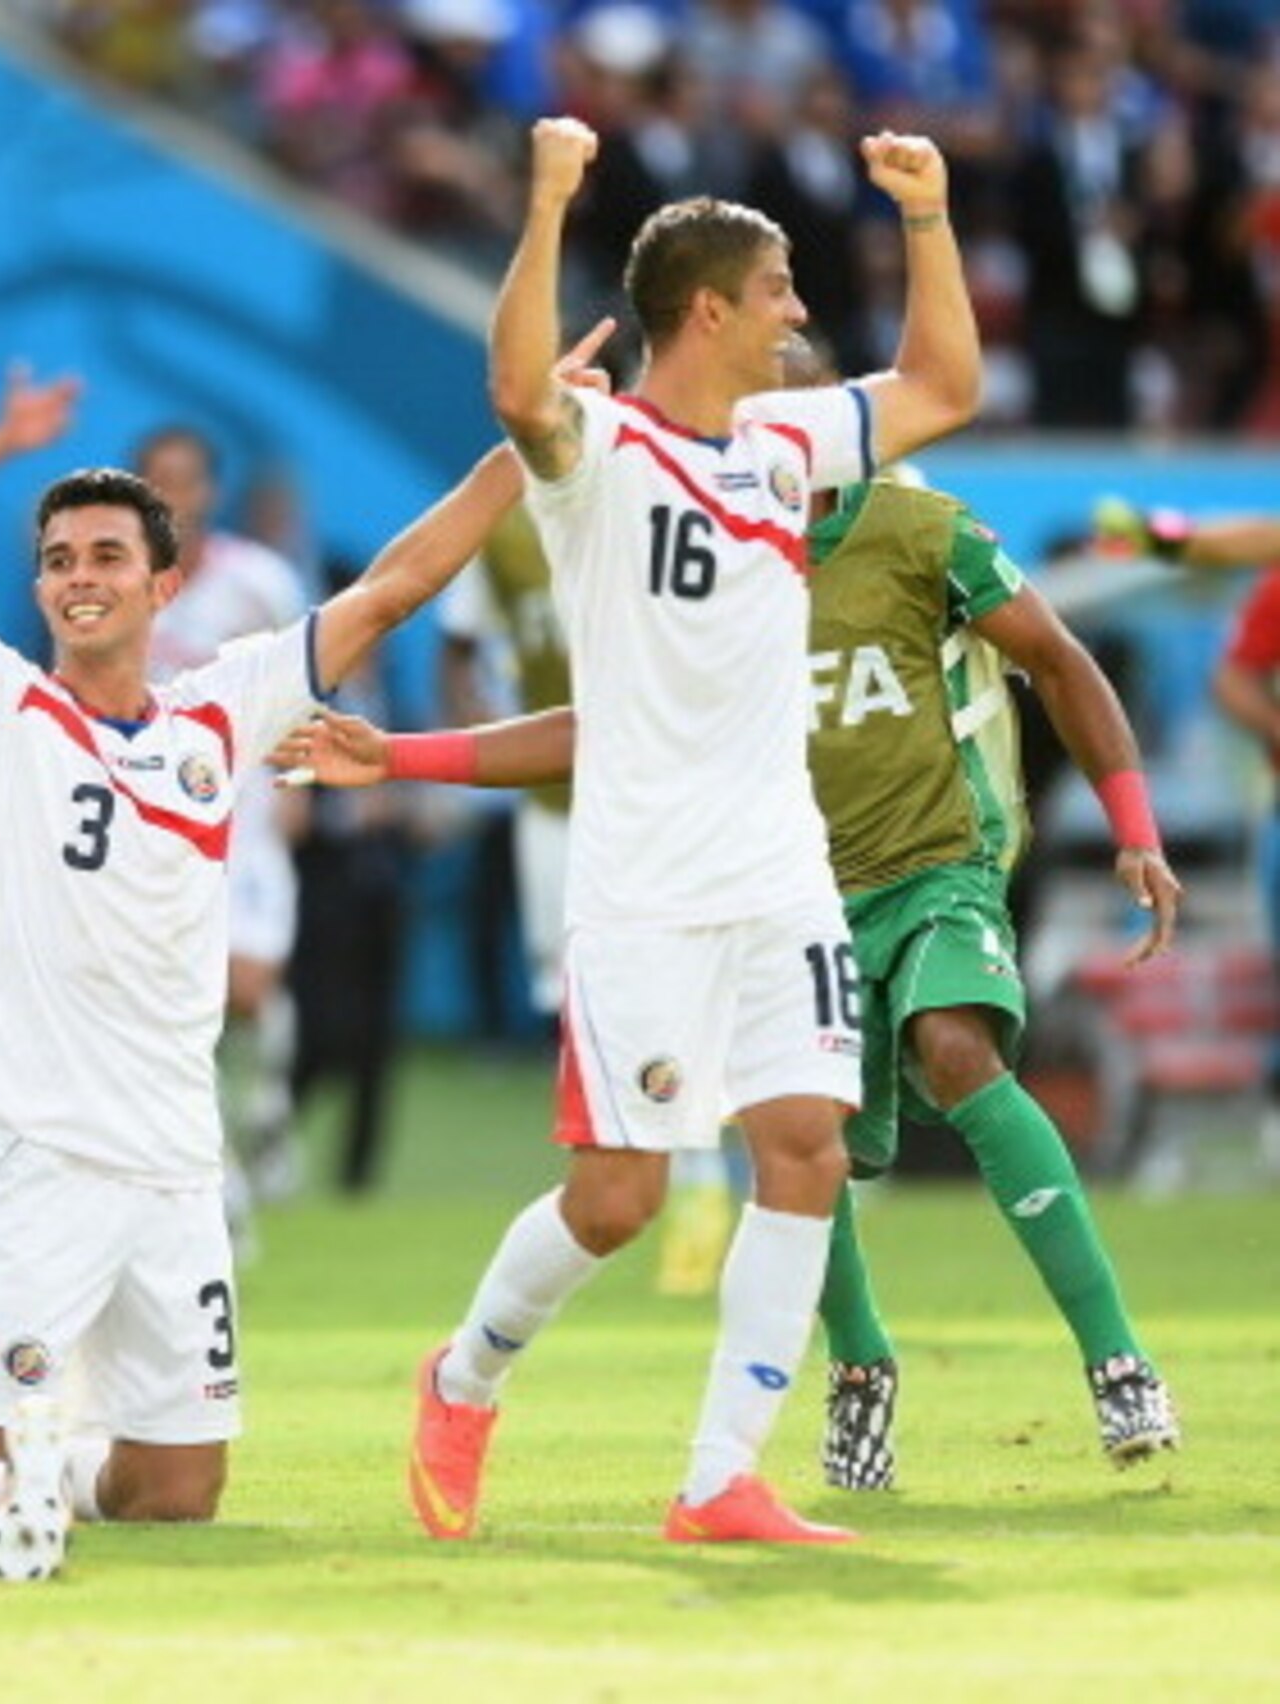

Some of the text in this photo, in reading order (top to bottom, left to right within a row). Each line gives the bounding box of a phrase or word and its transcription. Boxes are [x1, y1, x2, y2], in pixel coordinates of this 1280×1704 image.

[648, 505, 716, 600] 16
[63, 783, 114, 870] 3
[805, 942, 861, 1029] 16
[199, 1279, 232, 1369] 3
